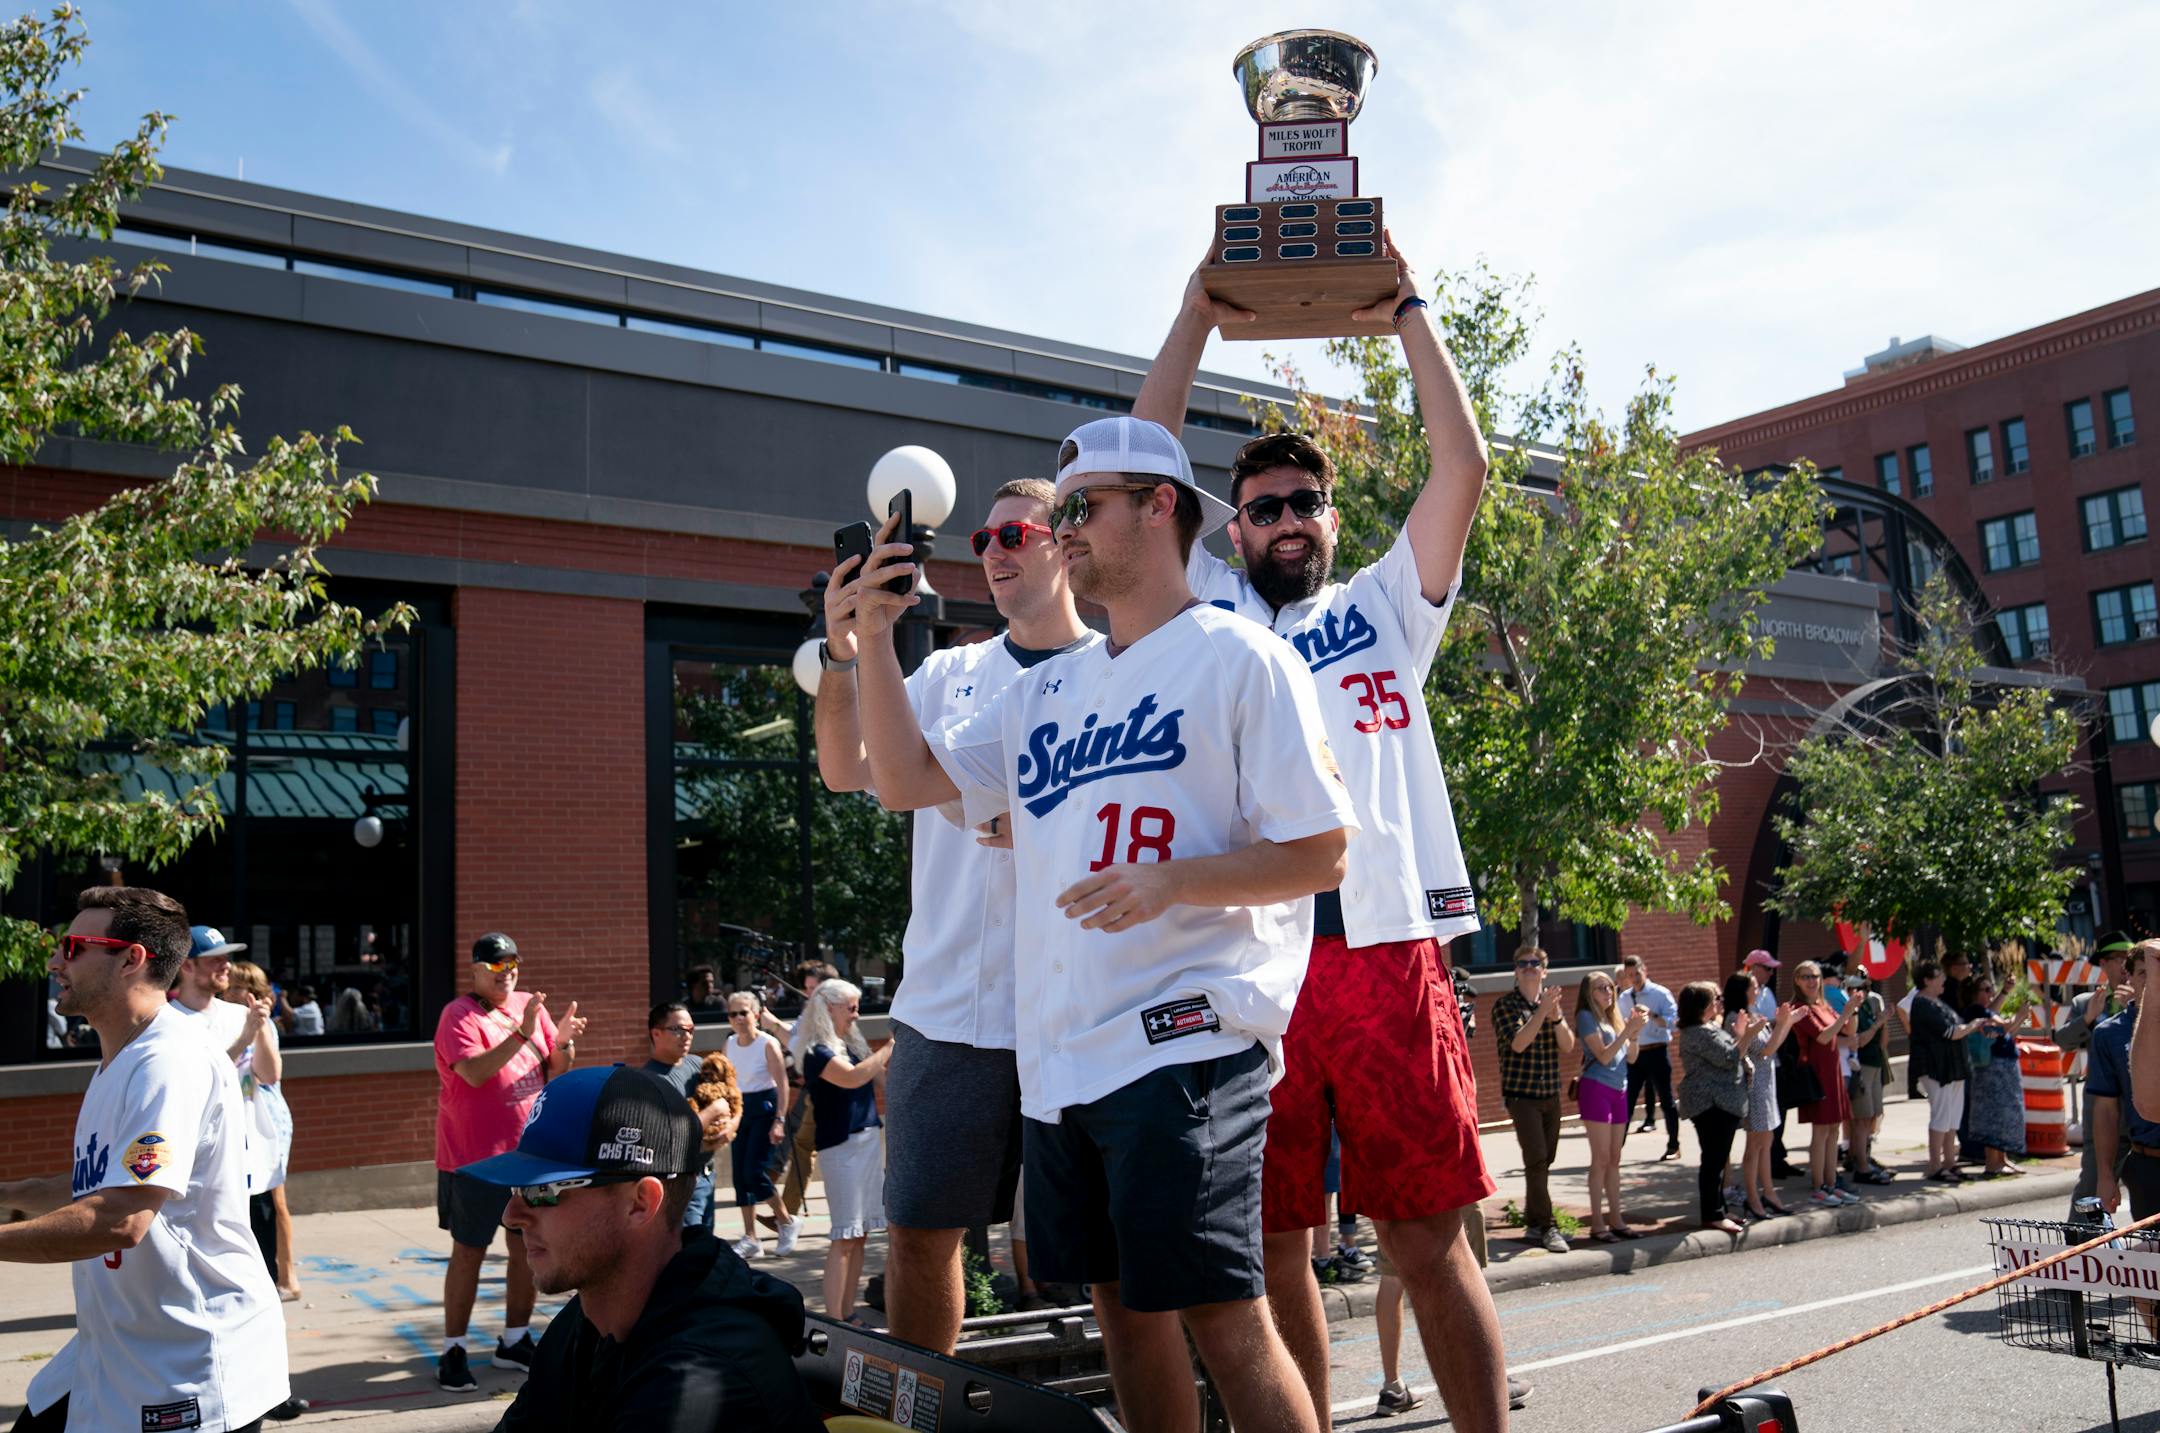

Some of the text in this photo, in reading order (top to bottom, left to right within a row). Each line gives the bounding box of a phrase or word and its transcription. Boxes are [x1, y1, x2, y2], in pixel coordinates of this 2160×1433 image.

[1268, 128, 1337, 142] MILES WOLFF
[1282, 141, 1323, 152] TROPHY
[1276, 171, 1330, 184] AMERICAN
[1760, 619, 1803, 639] NORTH
[1340, 671, 1411, 733] 35
[1018, 693, 1187, 808] Saints
[1090, 803, 1176, 872] 18
[73, 1131, 109, 1193] ints
[598, 1142, 654, 1164] CHS FIELD
